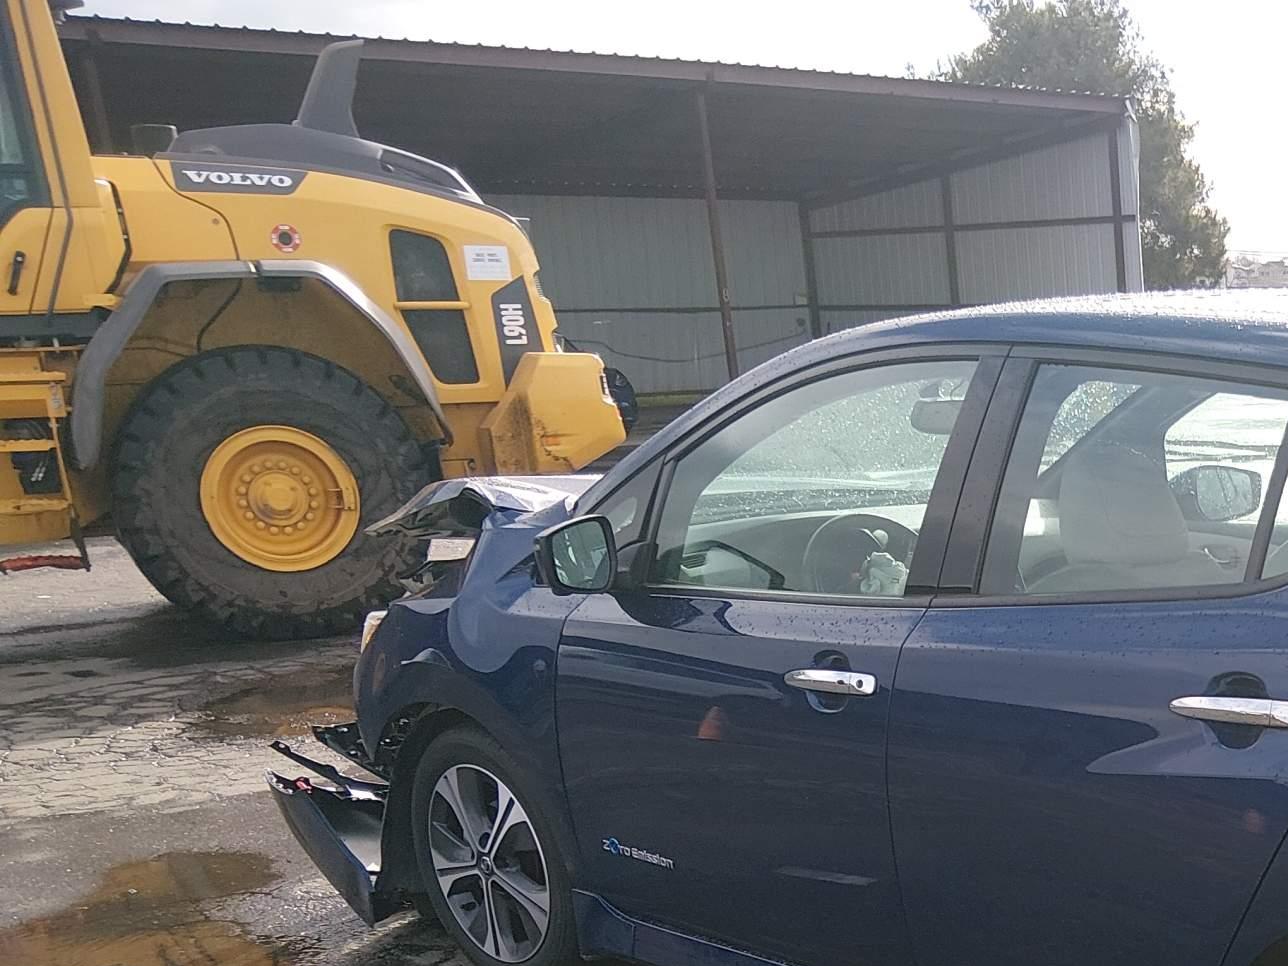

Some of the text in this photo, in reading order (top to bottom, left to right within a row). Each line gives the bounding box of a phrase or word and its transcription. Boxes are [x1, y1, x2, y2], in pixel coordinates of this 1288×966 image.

[181, 169, 293, 187] VOLVO
[499, 303, 529, 345] L90H
[631, 846, 674, 870] Emission
